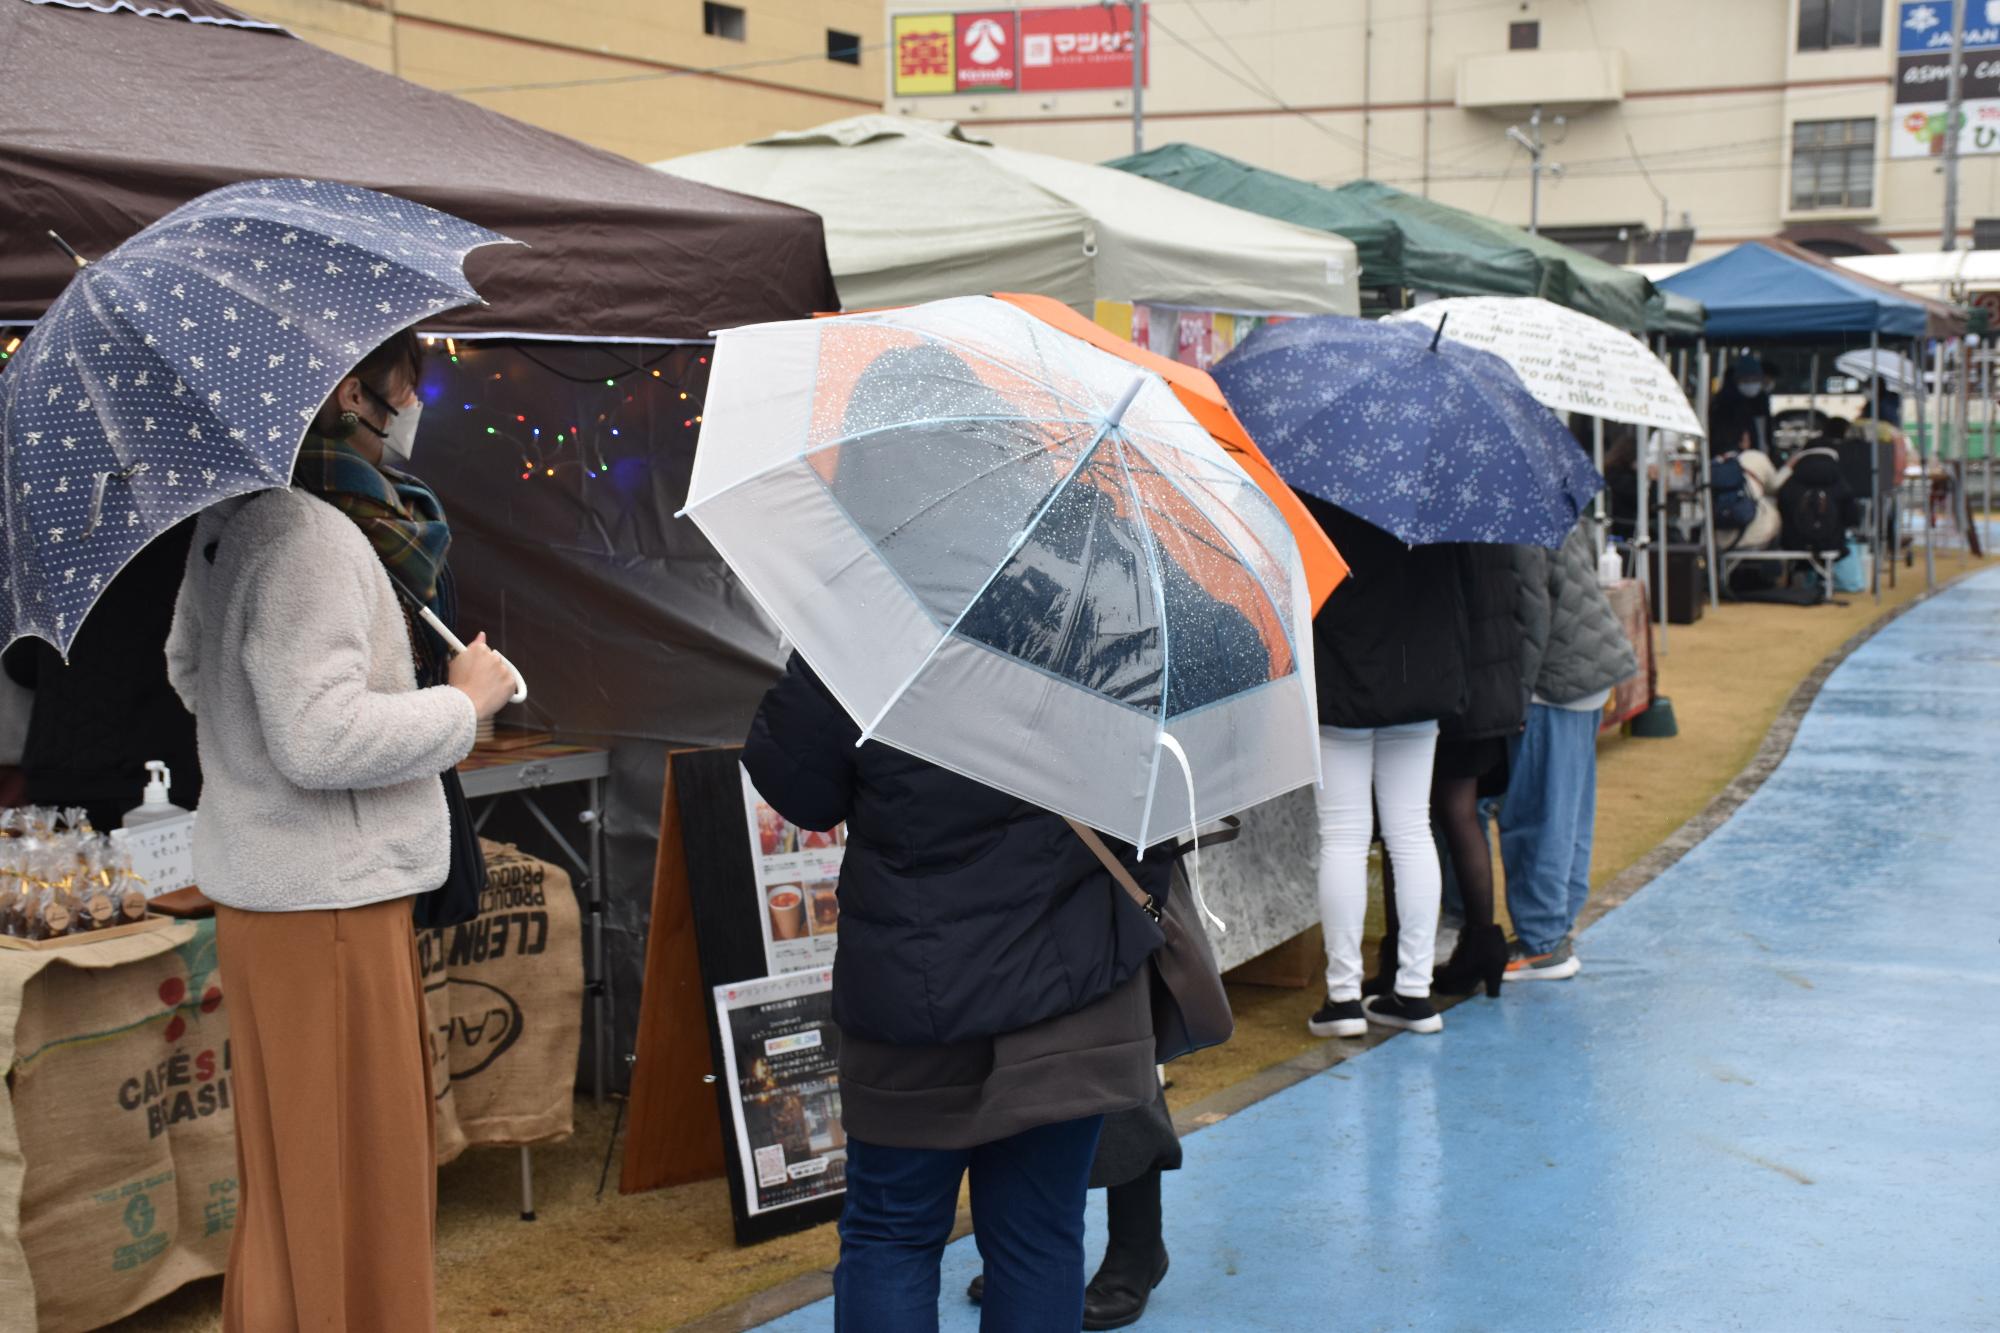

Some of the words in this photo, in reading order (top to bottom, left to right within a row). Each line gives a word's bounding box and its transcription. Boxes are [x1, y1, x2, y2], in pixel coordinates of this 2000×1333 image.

[1927, 27, 1999, 47] JAAN
[447, 911, 548, 967] CLEAN
[118, 1048, 216, 1111] CAFÉS
[146, 1077, 231, 1140] BRASI
